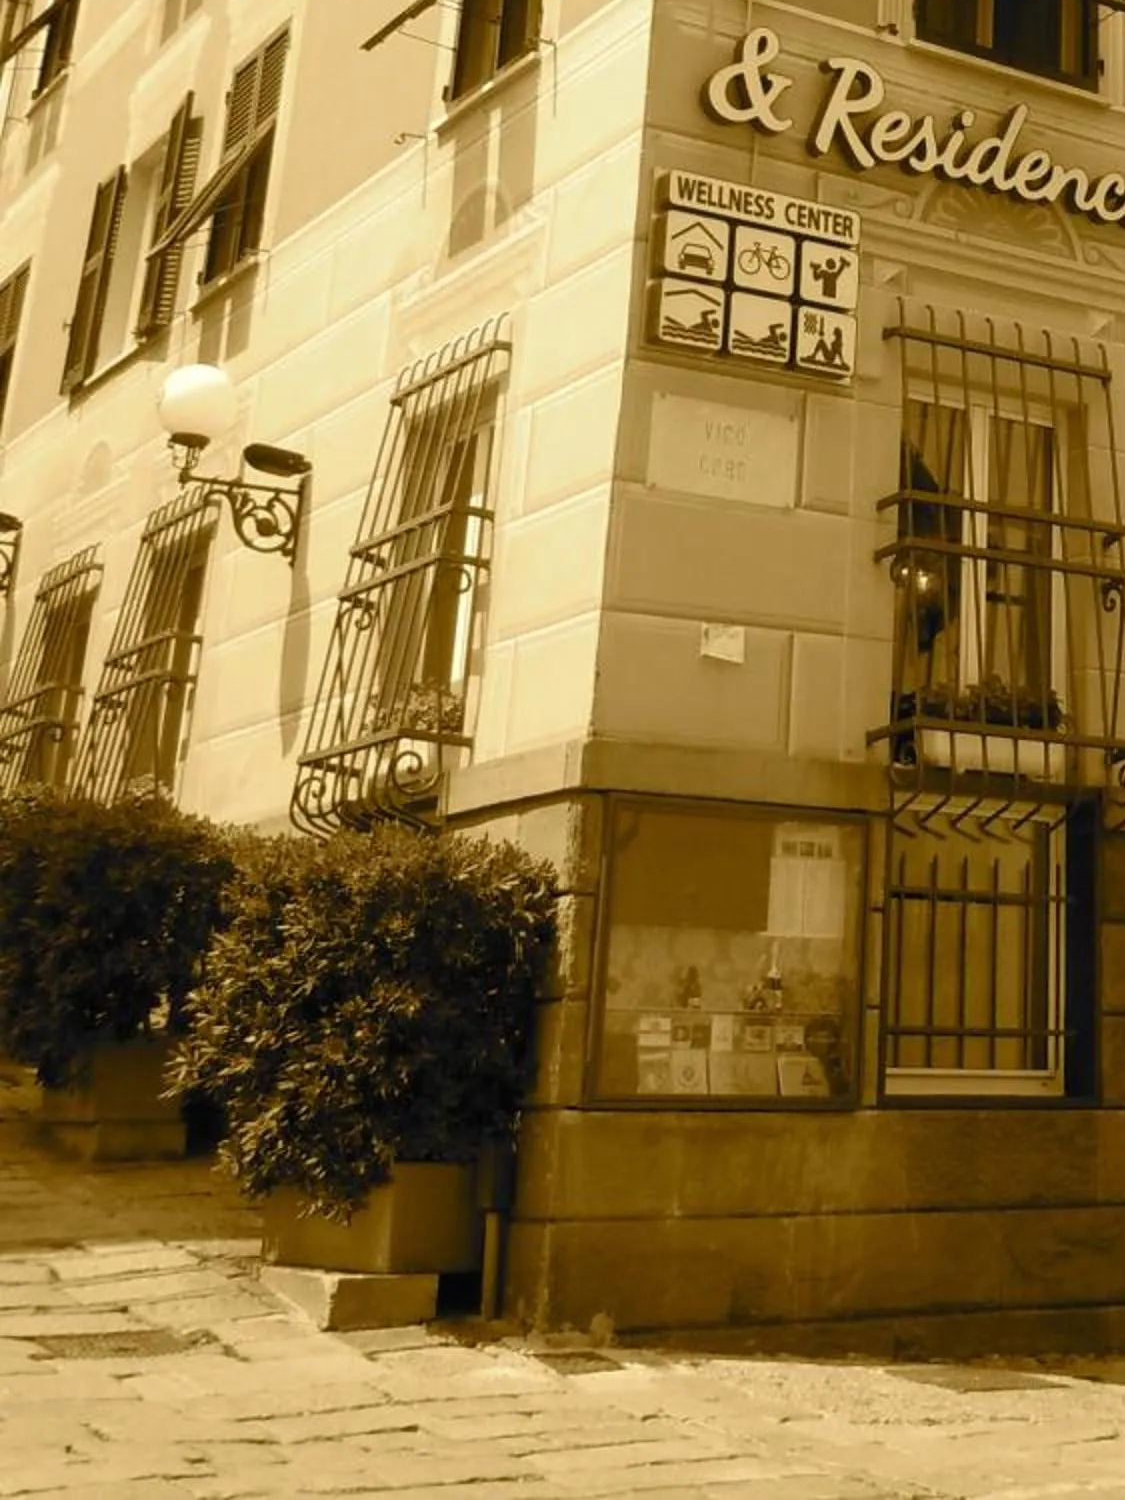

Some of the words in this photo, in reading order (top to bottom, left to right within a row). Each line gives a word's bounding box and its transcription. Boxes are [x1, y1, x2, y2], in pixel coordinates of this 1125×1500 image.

[707, 26, 794, 133] &
[676, 175, 776, 220] WELLNESS
[784, 202, 854, 238] CENTER
